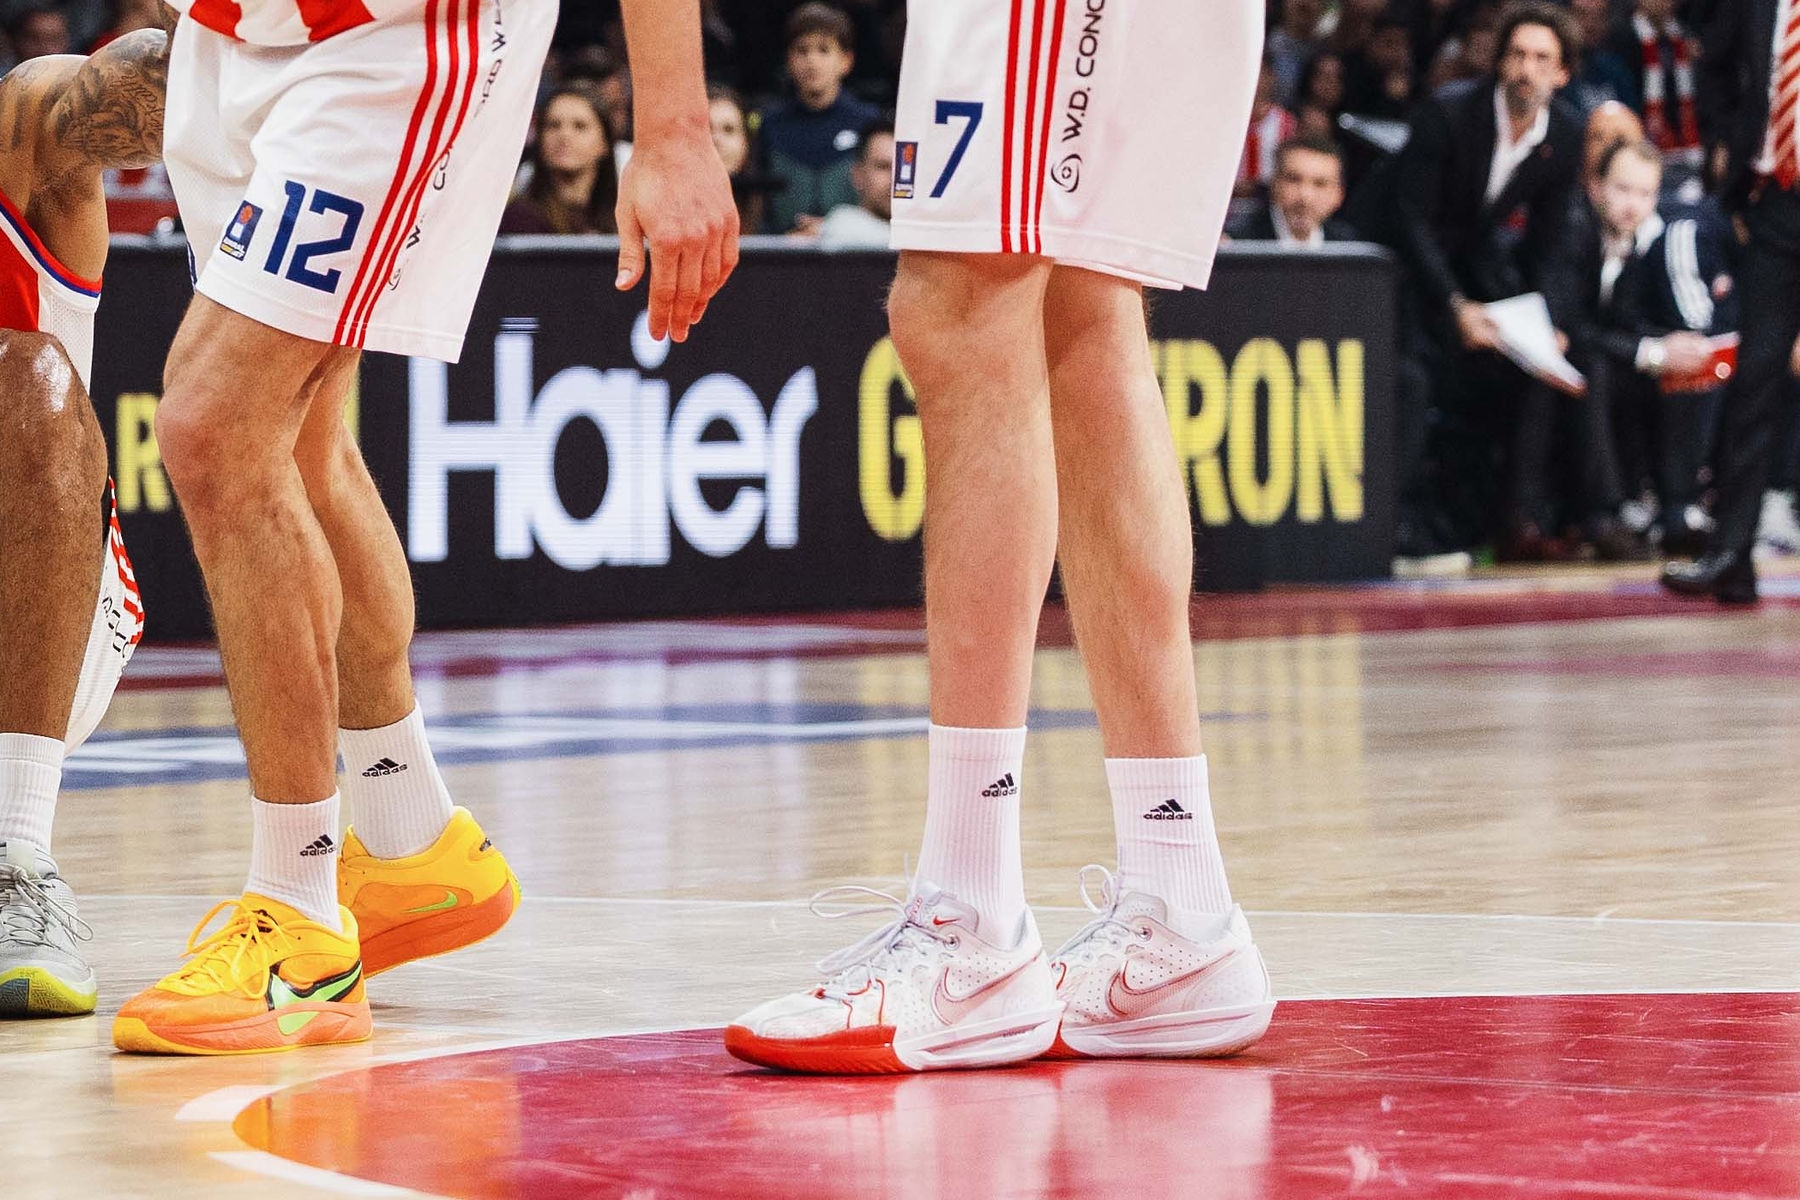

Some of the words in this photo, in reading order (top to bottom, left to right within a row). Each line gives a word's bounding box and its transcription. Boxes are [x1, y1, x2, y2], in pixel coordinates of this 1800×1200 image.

[929, 99, 984, 198] 7
[1062, 86, 1092, 142] W.D.
[263, 179, 365, 294] 12
[408, 310, 819, 571] Haier
[361, 763, 408, 778] adidas
[1142, 811, 1193, 821] adidas
